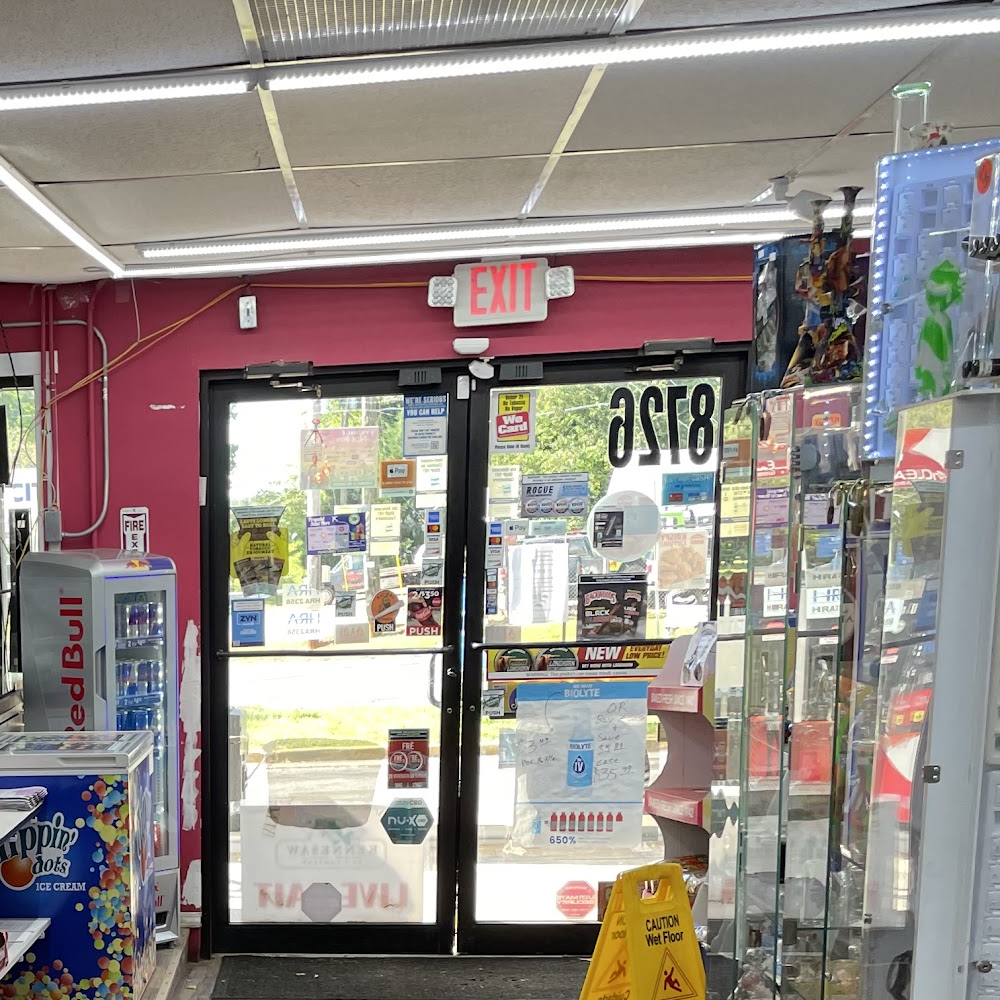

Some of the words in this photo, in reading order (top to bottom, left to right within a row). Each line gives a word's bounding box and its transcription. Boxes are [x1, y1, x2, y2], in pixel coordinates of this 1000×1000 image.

[471, 262, 537, 315] EXIT
[405, 396, 421, 404] WE'RE
[423, 395, 446, 404] SERIOUS
[407, 408, 417, 416] YOU
[431, 407, 445, 415] HELP
[502, 415, 523, 425] We
[497, 422, 528, 434] Card
[526, 486, 554, 495] ROGUE
[125, 520, 144, 531] FIRE
[376, 623, 394, 632] PUSH
[409, 626, 439, 636] PUSH
[60, 598, 84, 669] Bull
[585, 646, 621, 660] NEW
[642, 651, 665, 659] PRICE!
[564, 688, 600, 698] BIOLYTE
[61, 677, 85, 731] ed
[607, 702, 629, 714] OR
[574, 761, 585, 772] IV
[549, 836, 576, 844] 650%
[32, 855, 68, 874] dots
[35, 882, 52, 892] ICE
[53, 882, 86, 892] CREAM
[645, 914, 680, 932] CAUTION
[645, 933, 663, 947] Wet
[663, 930, 684, 944] Floor
